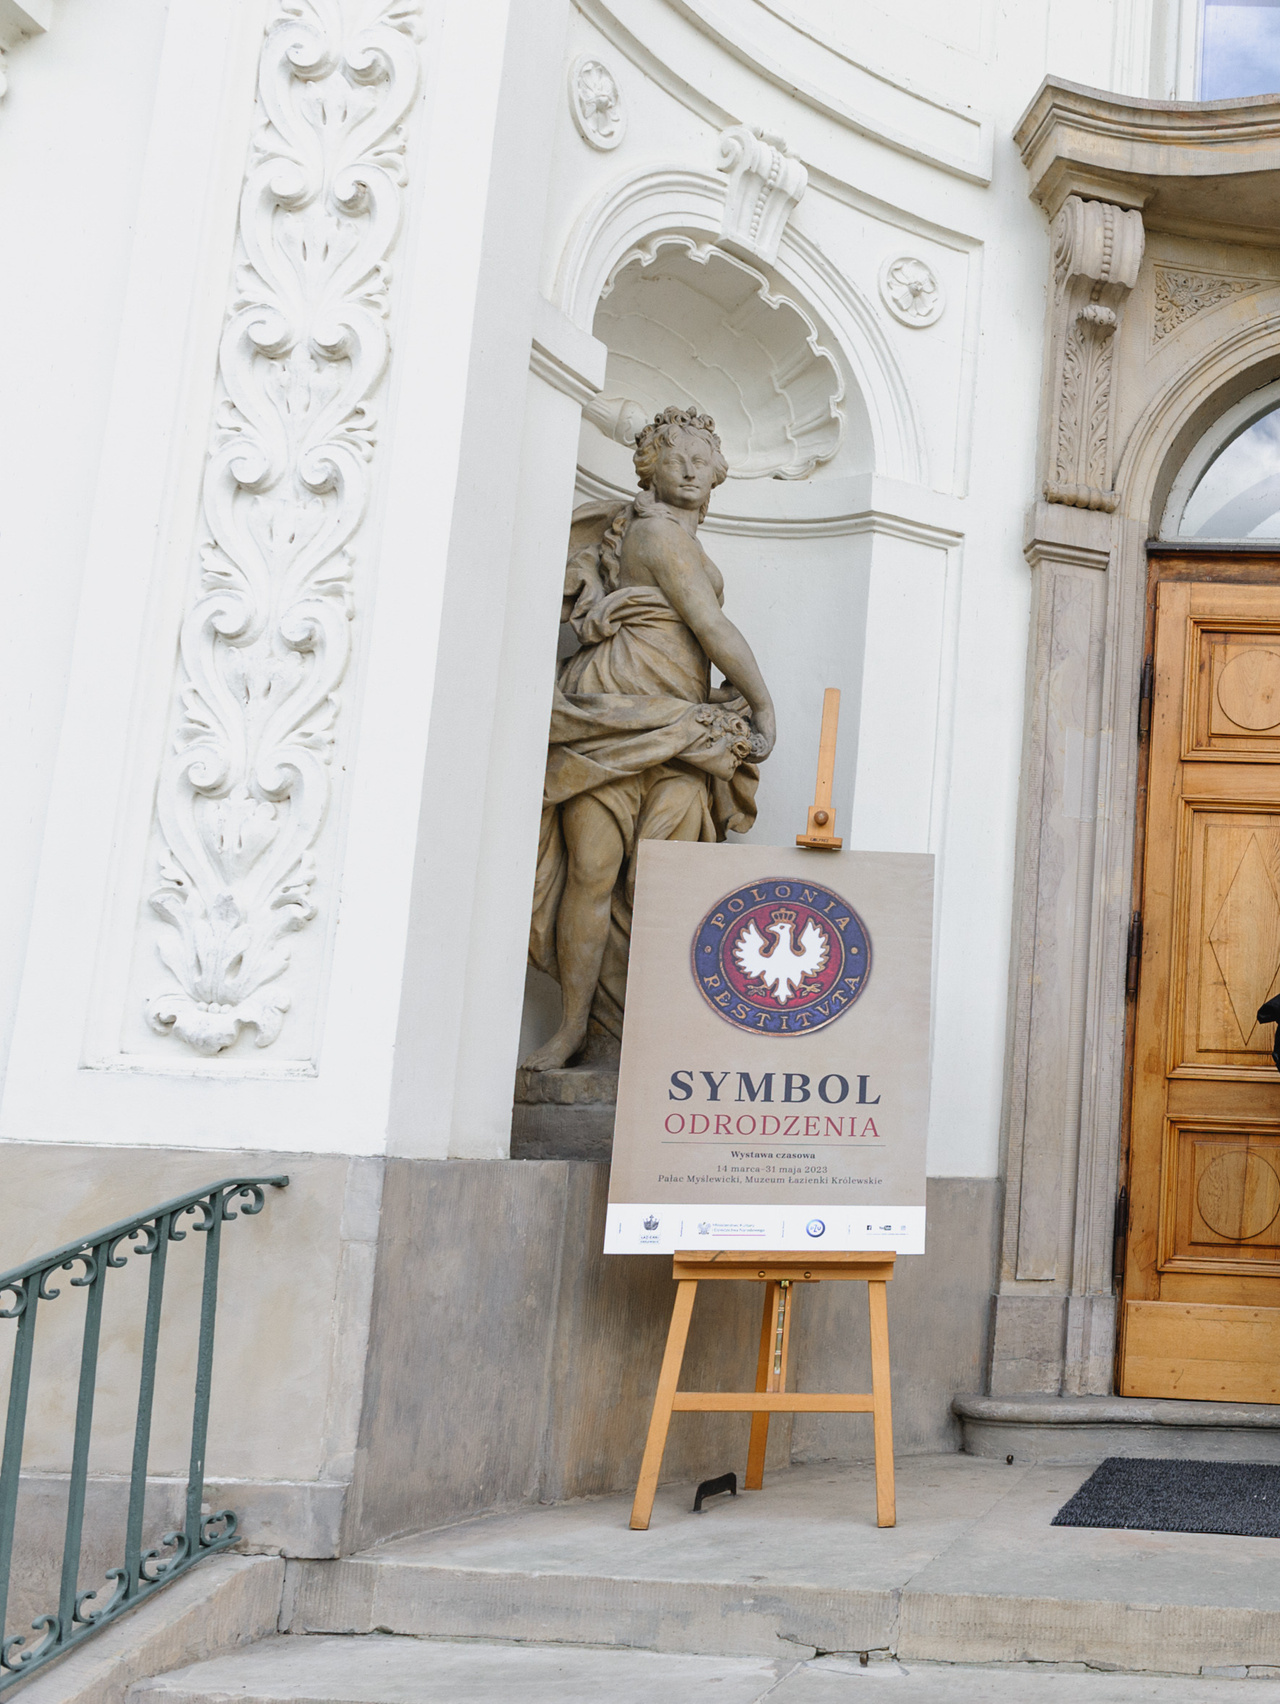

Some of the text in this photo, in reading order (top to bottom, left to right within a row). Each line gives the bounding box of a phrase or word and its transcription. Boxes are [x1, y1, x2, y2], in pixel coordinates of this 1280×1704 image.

[711, 885, 851, 931] POLONIA
[704, 973, 860, 1029] RESTITVTA
[669, 1070, 881, 1105] SYMBOL
[664, 1113, 880, 1137] ODRODZENIA
[730, 1150, 816, 1160] Wystawa czasowa
[658, 1174, 883, 1186] Pałac Myślewicki, Muzeum Łazienki Królewskie
[717, 1165, 727, 1173] 14
[779, 1166, 802, 1175] maja
[804, 1166, 828, 1174] 2023
